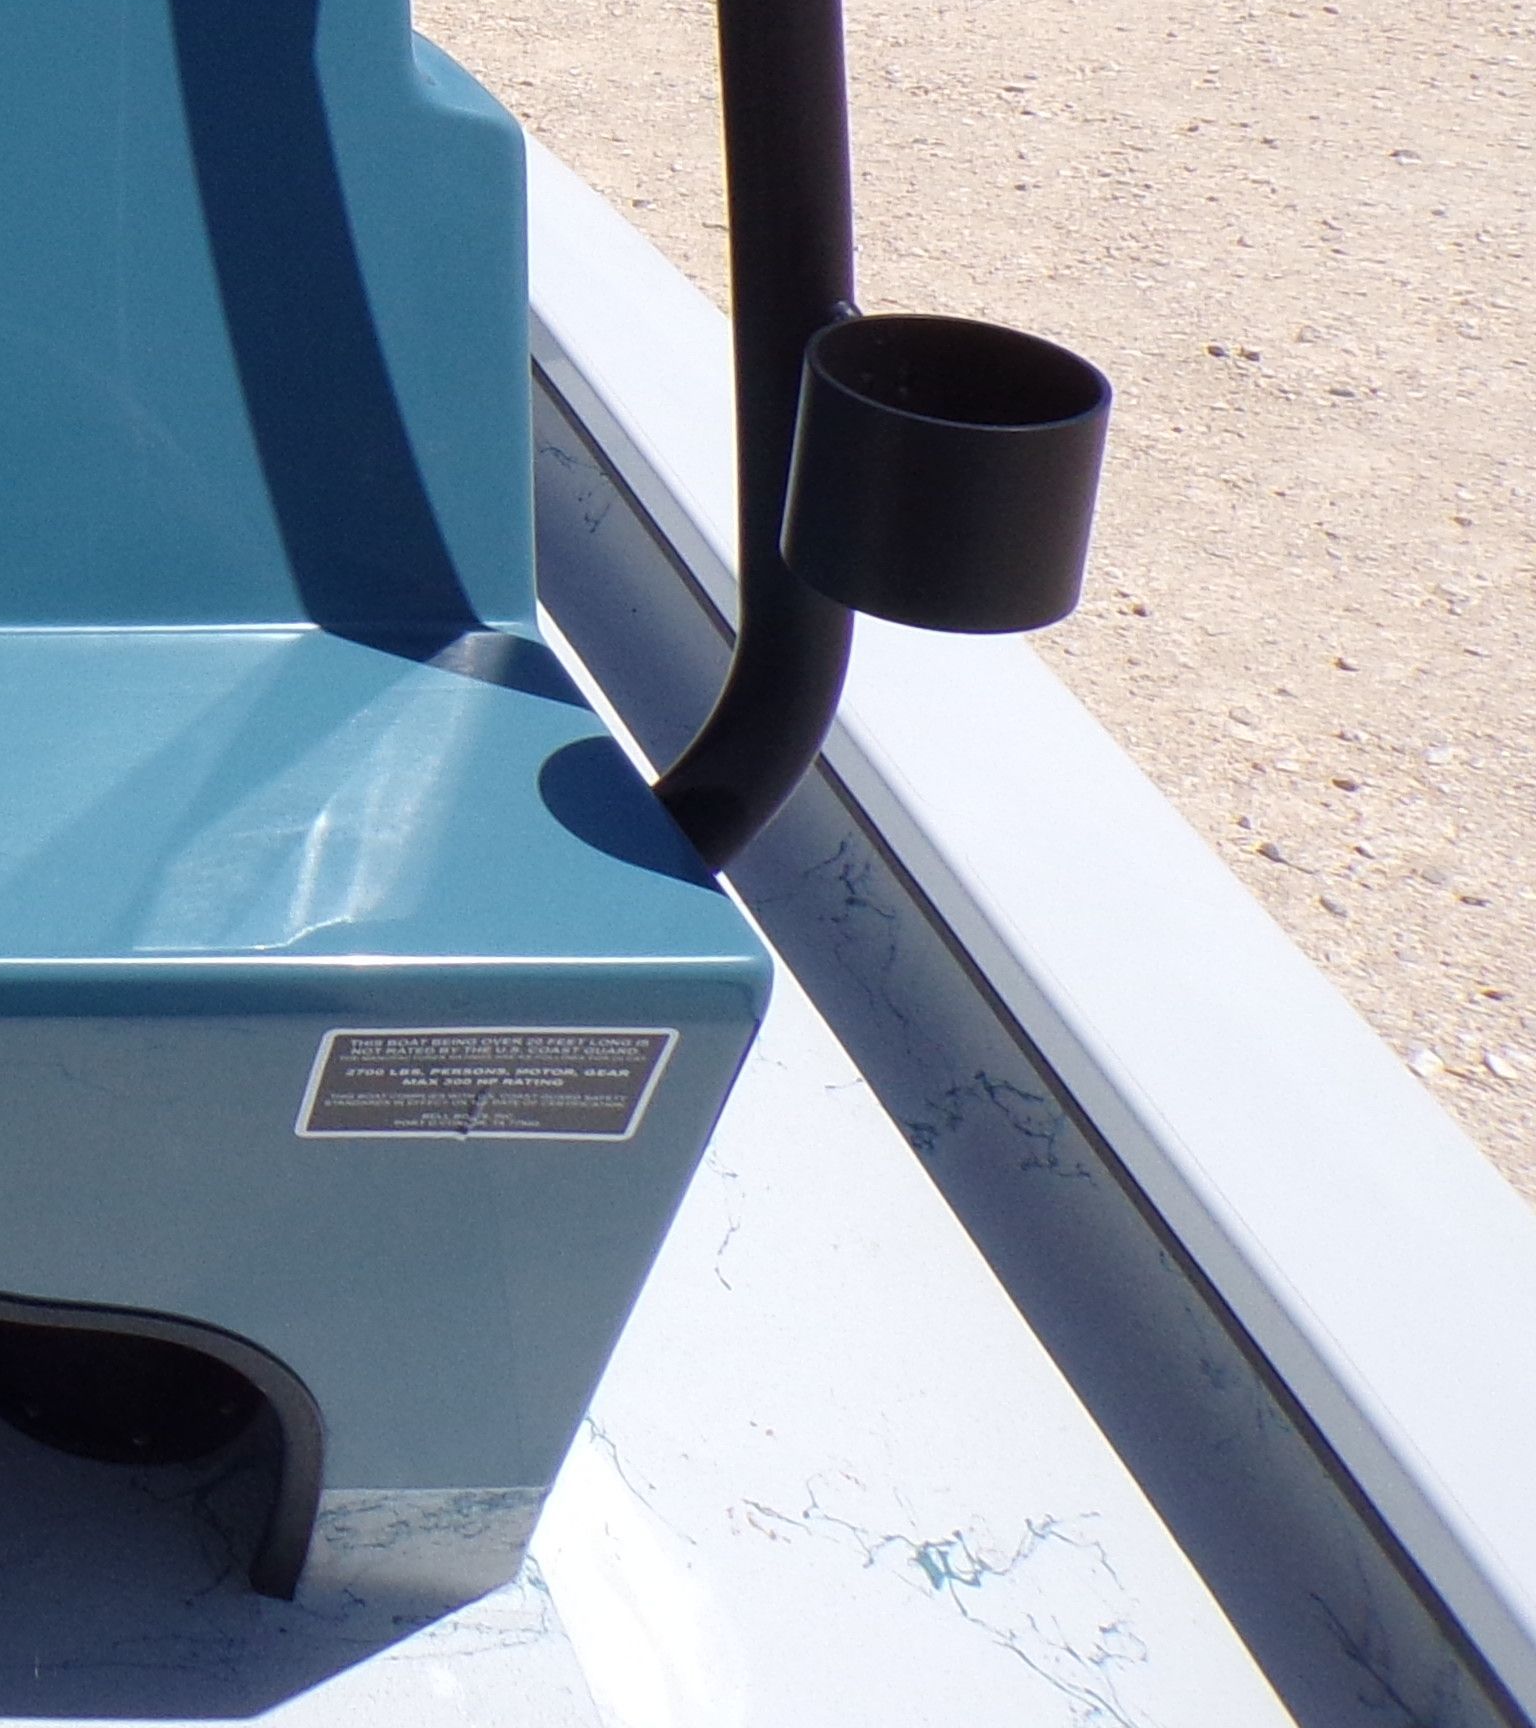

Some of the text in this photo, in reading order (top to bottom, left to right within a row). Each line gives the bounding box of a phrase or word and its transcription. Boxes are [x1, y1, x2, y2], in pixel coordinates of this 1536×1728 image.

[387, 1038, 428, 1047] BOAT
[582, 1068, 631, 1078] GEAR
[402, 1078, 439, 1087] MAX
[501, 1077, 565, 1087] RATING
